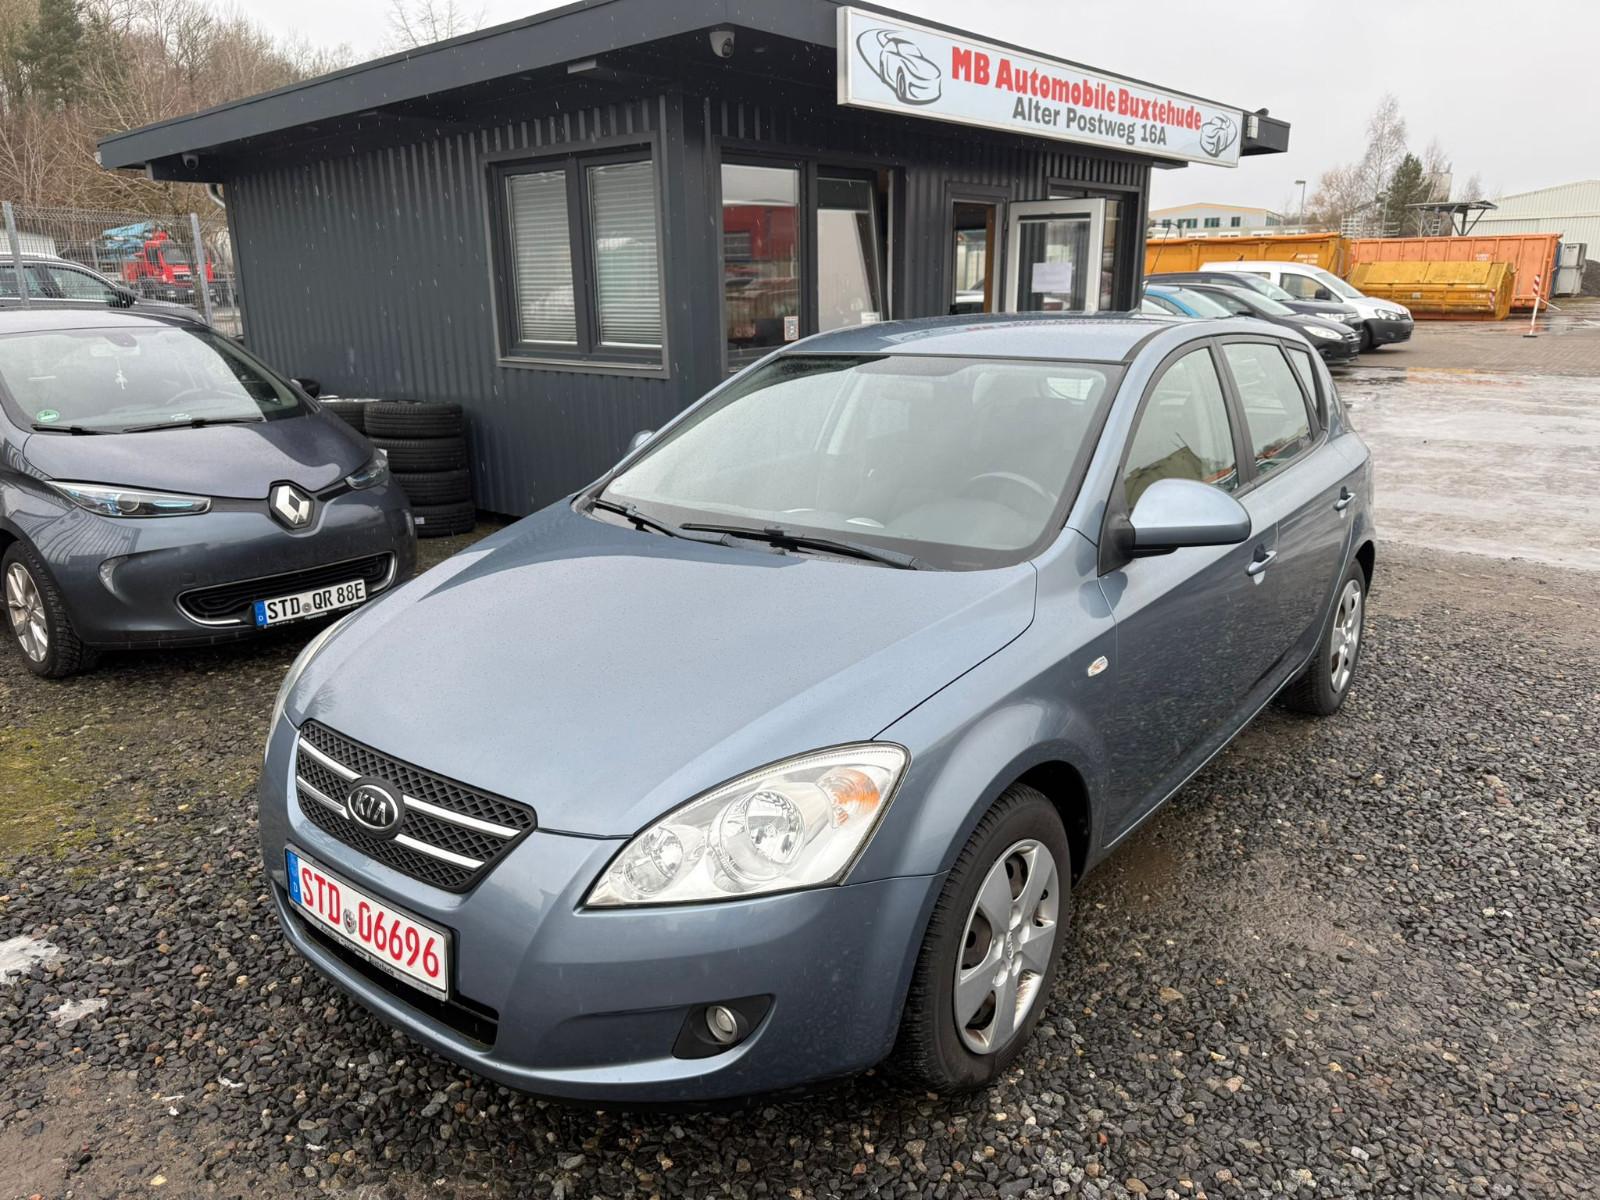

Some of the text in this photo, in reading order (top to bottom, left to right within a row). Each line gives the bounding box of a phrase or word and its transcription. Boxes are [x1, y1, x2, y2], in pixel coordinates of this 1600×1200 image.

[952, 45, 1202, 131] MB Automobile Buxtehude
[1012, 96, 1168, 146] Alter Postweg 16A
[266, 582, 365, 620] STD QR 88E
[354, 790, 387, 826] KIA
[301, 867, 341, 925] STD
[358, 901, 439, 978] 06696
